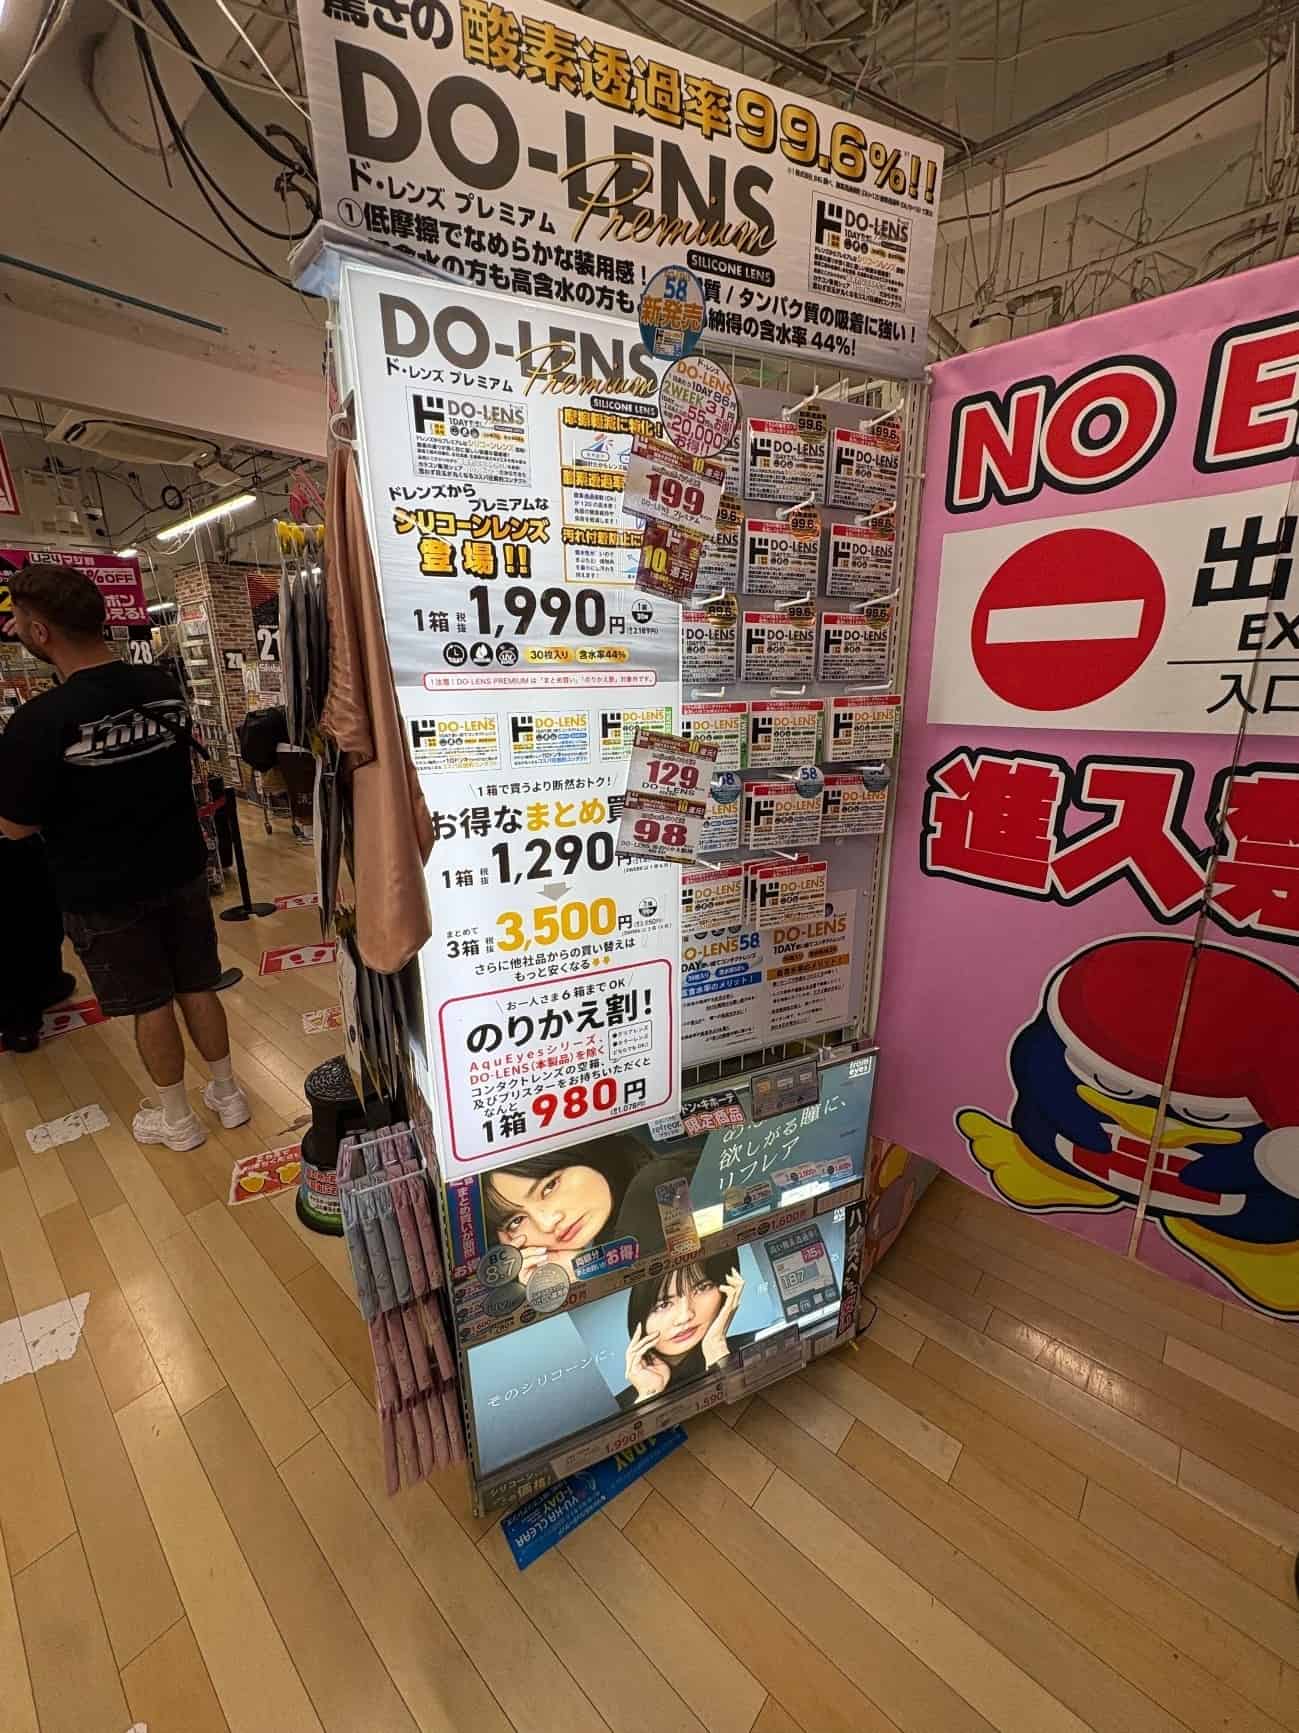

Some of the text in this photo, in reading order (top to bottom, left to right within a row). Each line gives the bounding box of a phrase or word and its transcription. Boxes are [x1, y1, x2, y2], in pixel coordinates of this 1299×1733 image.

[335, 40, 775, 256] DO-LENS
[349, 158, 556, 234] ド・レンズ プレミアム
[560, 153, 777, 250] Premium
[691, 255, 743, 278] SILICONE
[745, 268, 771, 284] LENS
[663, 278, 688, 299] 58
[641, 295, 705, 333] 新発売
[379, 293, 660, 397] DO-LENS
[385, 357, 513, 393] ド・レンズ プレミアム
[514, 342, 661, 397] Premium
[593, 398, 657, 417] SILICONE LENS
[663, 380, 705, 408] 2WEEK
[448, 400, 525, 425] DO-LENS
[945, 355, 1177, 514] NO
[389, 483, 476, 501] ドレンズから
[468, 498, 549, 512] プレミアムな
[645, 473, 705, 516] 199
[394, 508, 550, 544] シリコーンレンズ
[413, 608, 449, 633] 1箱
[469, 585, 606, 638] 1,990
[609, 616, 626, 634] 円
[438, 718, 496, 733] DO-LENS
[535, 714, 587, 729] DO-LENS
[623, 709, 665, 722] DO-LENS
[645, 760, 700, 790] 129
[801, 767, 818, 780] 58
[633, 819, 688, 847] 98
[442, 869, 474, 889] 1箱
[492, 831, 615, 884] 1,290
[446, 939, 480, 958] 3箱
[496, 897, 618, 952] 3,500
[618, 915, 633, 931] 円
[772, 917, 847, 944] DO-LENS
[514, 958, 592, 983] もっと安くなる
[466, 989, 652, 1053] のりかえ割!
[482, 1077, 647, 1143] 1箱 980 円
[484, 1102, 518, 1119] なんと
